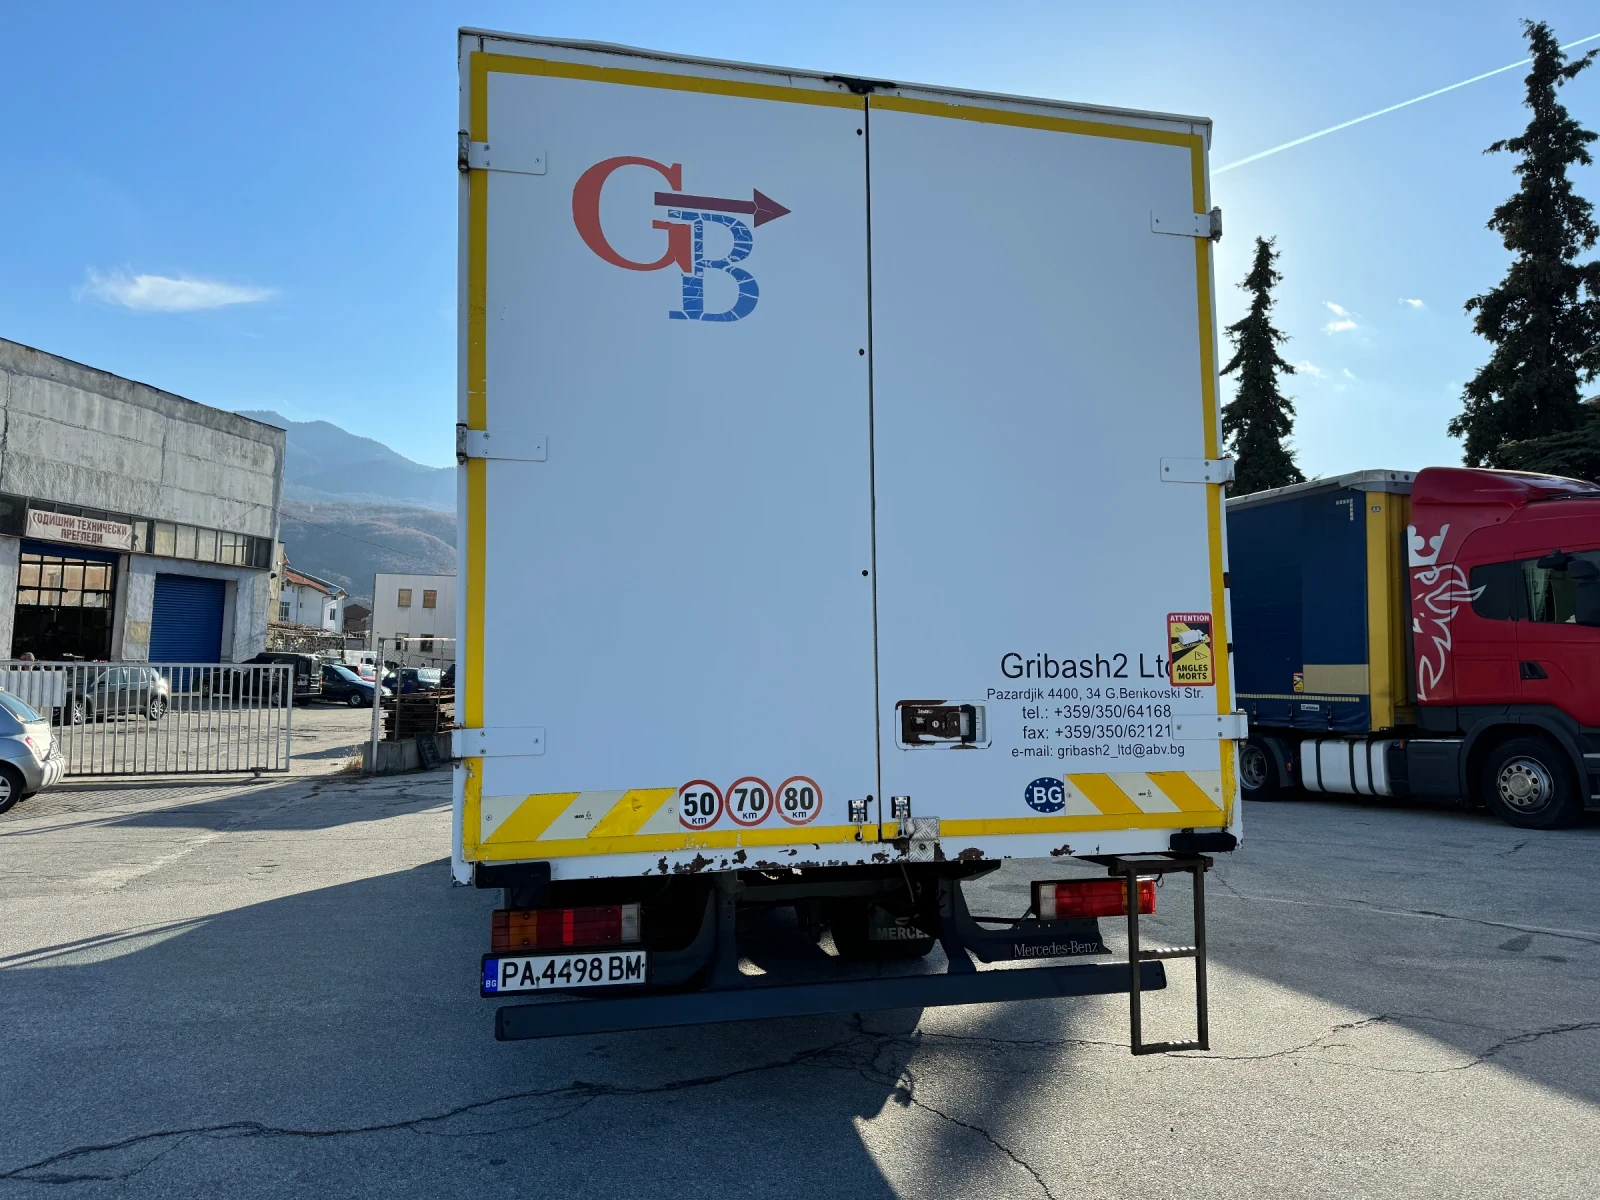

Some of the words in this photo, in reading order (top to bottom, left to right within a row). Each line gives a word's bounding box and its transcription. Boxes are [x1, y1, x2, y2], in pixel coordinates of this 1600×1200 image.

[33, 512, 75, 529] ГОДИШНИ
[77, 519, 127, 535] ТЕХНИЧЕСКИ
[61, 528, 103, 544] ПРЕГЛЕДИ
[1001, 652, 1128, 679] Gribash2
[1176, 664, 1208, 672] ANGLES
[1178, 672, 1207, 680] MORTS
[987, 688, 1044, 702] Pazardjik
[1047, 687, 1082, 701] 4400,
[1086, 687, 1101, 699] 34
[1105, 687, 1180, 699] G.Benkovski
[1184, 687, 1204, 699] Str.
[1022, 705, 1048, 719] tel.:
[1054, 704, 1172, 719] +359/350/64168
[1022, 725, 1049, 740] fax:
[1055, 724, 1171, 739] +359/350/62121
[1011, 745, 1053, 757] e-mail:
[1057, 743, 1186, 759] gribash2_ltd@abv.bg
[734, 787, 765, 811] 70
[784, 787, 814, 811] 80
[1033, 786, 1062, 804] BG
[684, 792, 715, 817] 50
[876, 927, 931, 940] MERCE
[1014, 940, 1099, 958] Mercedes-Benz
[541, 957, 603, 985] 4498
[608, 954, 642, 981] BM
[485, 979, 497, 988] BG
